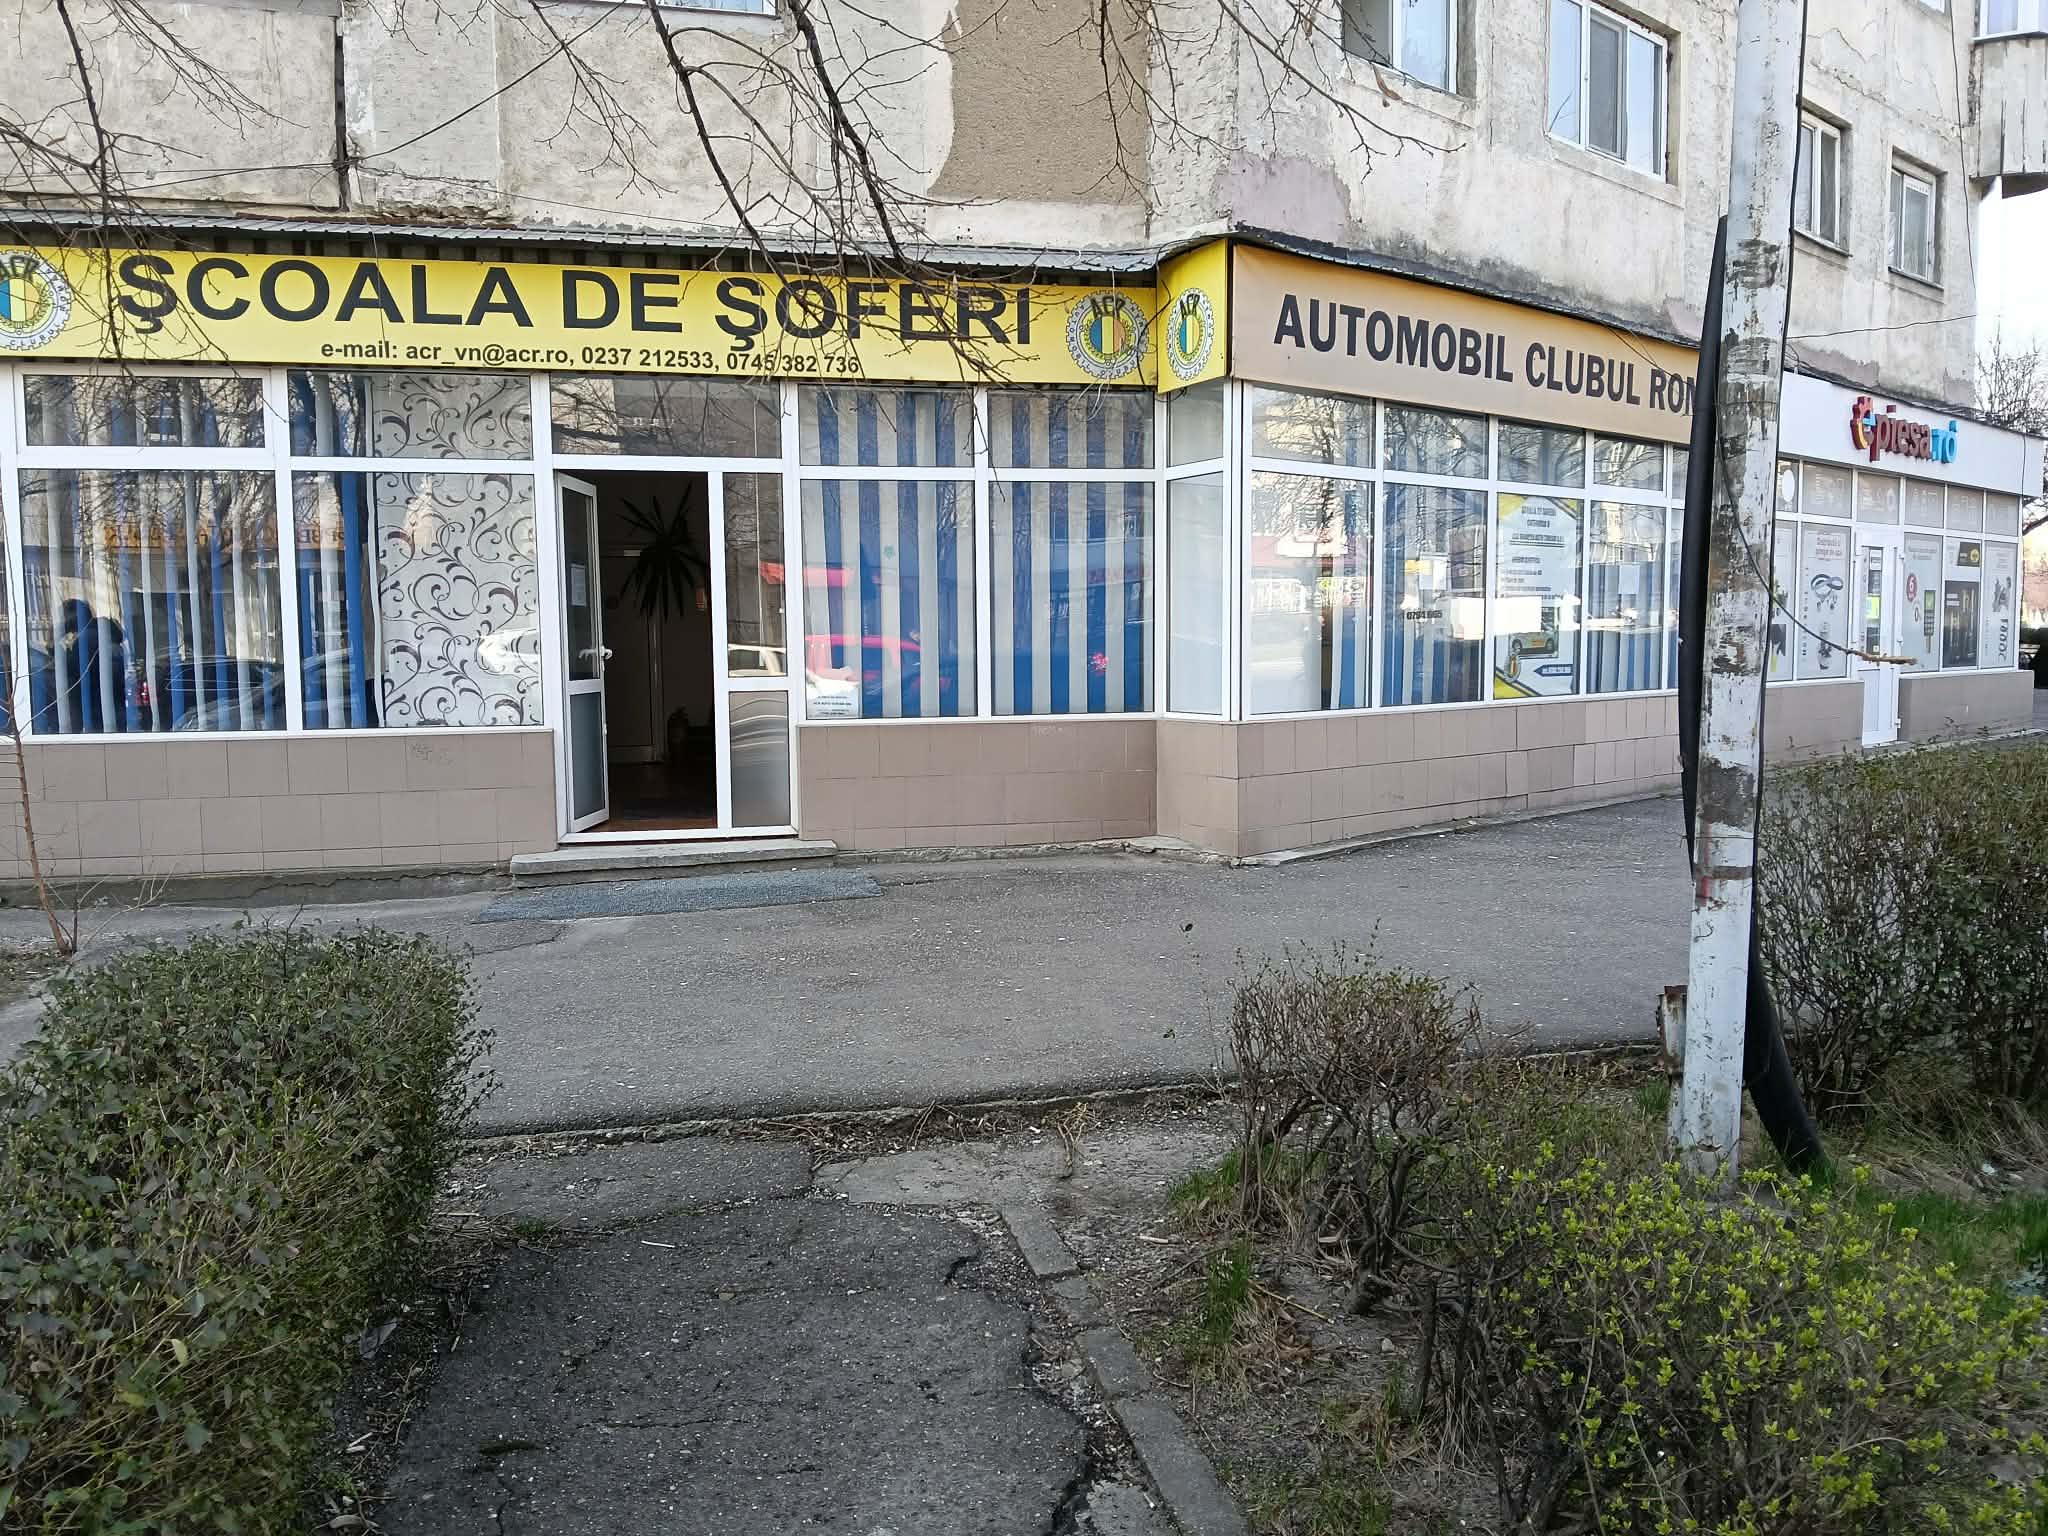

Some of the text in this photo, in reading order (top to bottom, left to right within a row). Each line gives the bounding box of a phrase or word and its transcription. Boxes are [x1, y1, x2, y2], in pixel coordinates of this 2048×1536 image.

[117, 254, 1031, 352] ŞCOALA DE ŞOFERI
[1273, 293, 1515, 383] AUTOMOBIL
[1525, 342, 1641, 406] CLUBUL
[320, 340, 398, 360] e-mail:
[405, 343, 575, 367] acr_vn@acr.ro,
[581, 346, 632, 366] 0237
[639, 348, 720, 372] 212533,
[781, 354, 818, 373] 382
[823, 355, 860, 374] 736
